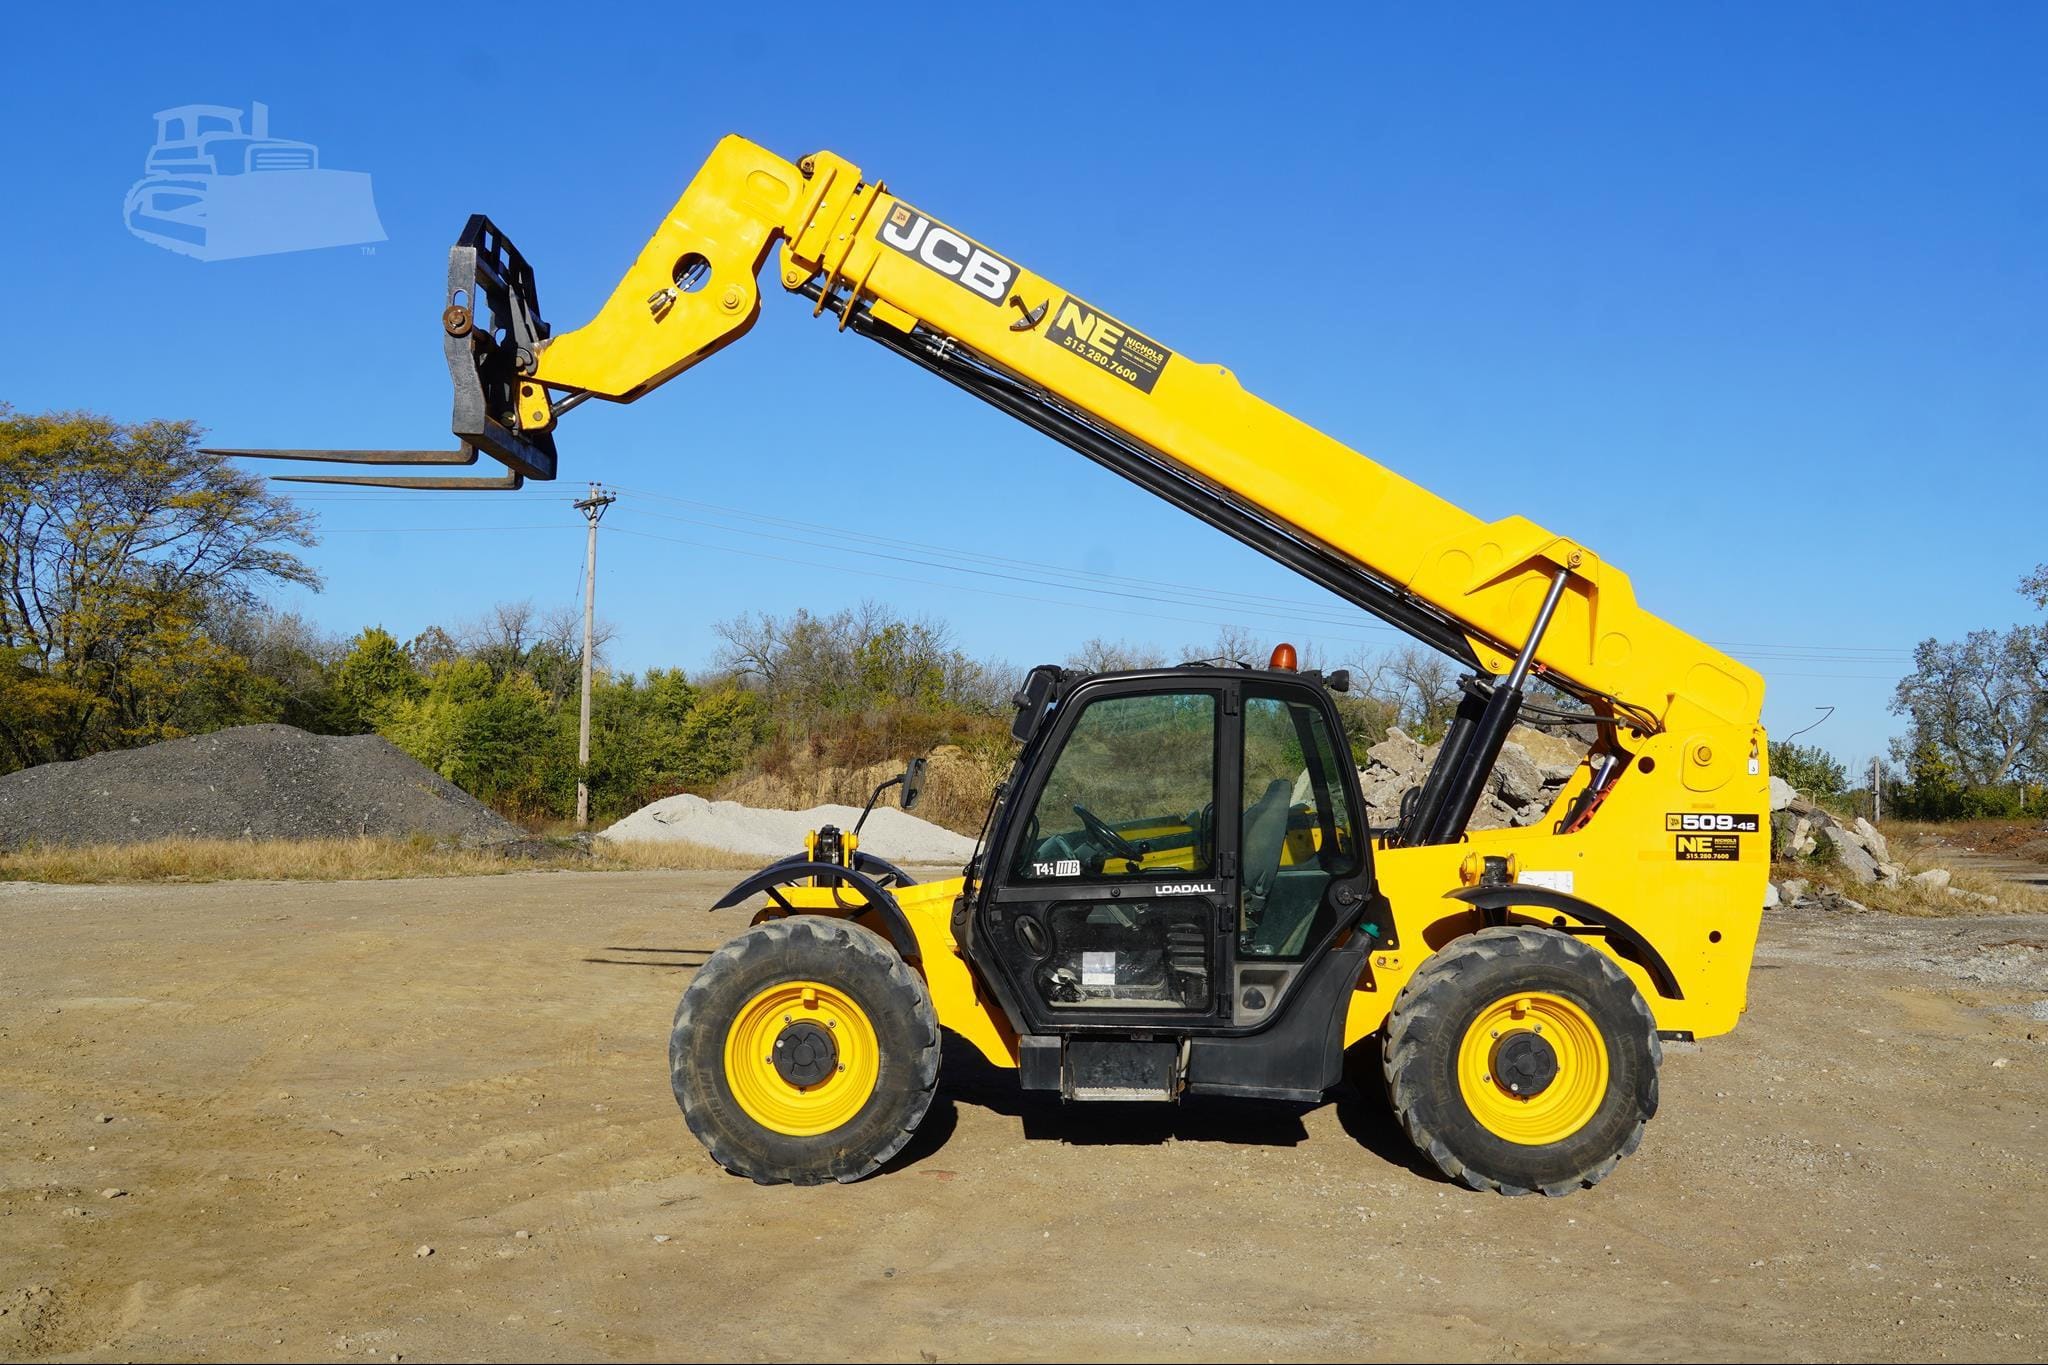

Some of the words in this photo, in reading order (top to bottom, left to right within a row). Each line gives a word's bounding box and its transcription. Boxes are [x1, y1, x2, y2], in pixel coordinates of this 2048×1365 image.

[882, 216, 1012, 300] JCB
[1056, 301, 1125, 356] NE
[1063, 335, 1138, 382] 515.280.7600
[1124, 336, 1164, 361] NICHOLS
[1682, 814, 1756, 831] 509-42
[1678, 836, 1713, 852] NE
[1033, 861, 1054, 876] T4i
[1155, 884, 1216, 894] LOADALL
